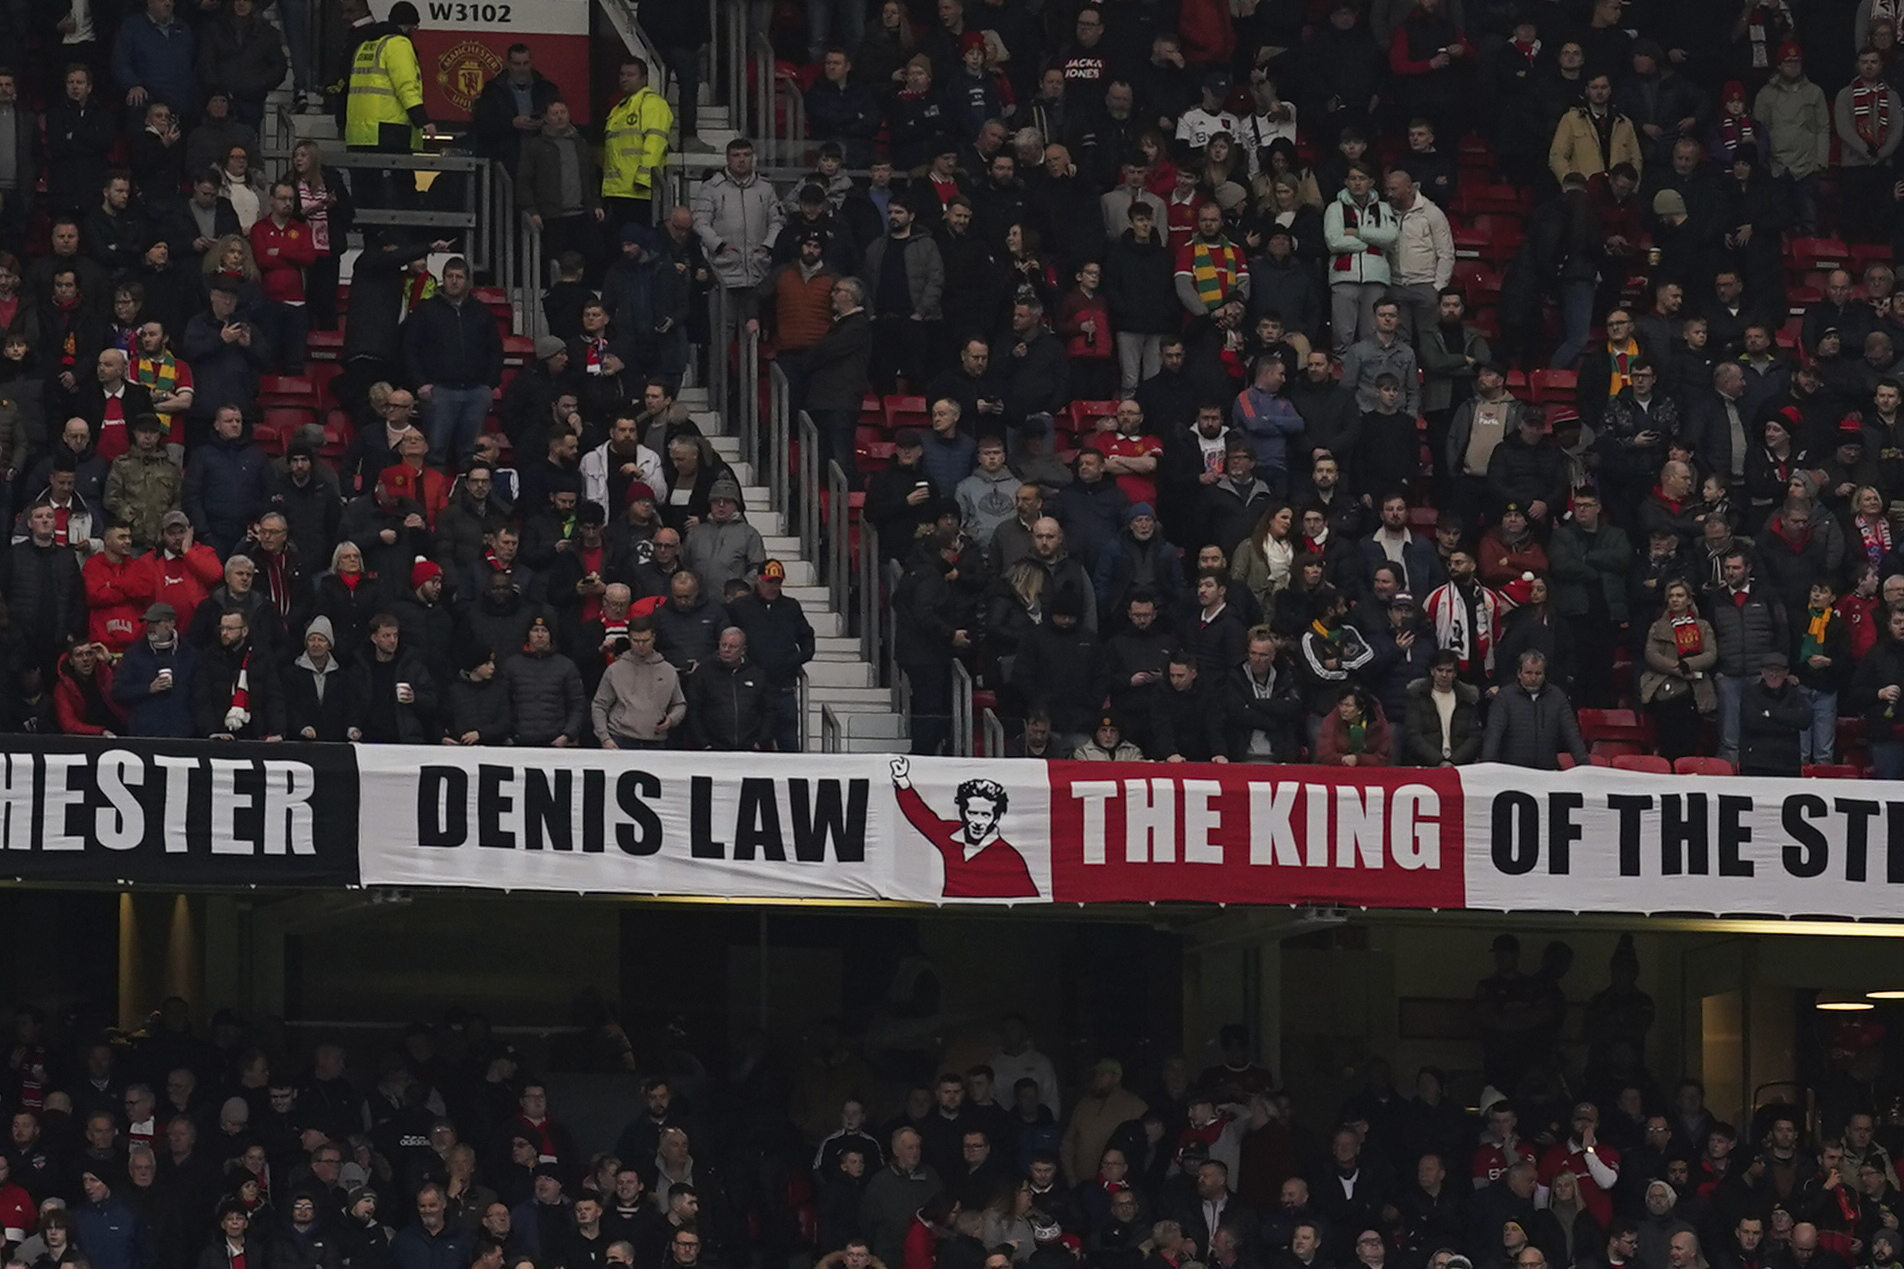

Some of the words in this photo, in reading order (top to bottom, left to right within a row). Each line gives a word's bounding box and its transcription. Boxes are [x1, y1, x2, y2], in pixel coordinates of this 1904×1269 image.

[428, 2, 511, 23] W3102
[444, 45, 498, 69] MANCHESTER
[1064, 68, 1101, 80] JONES
[418, 764, 662, 856] DENIS
[691, 776, 869, 862] LAW
[1071, 778, 1223, 864] THE
[1248, 782, 1440, 869] KING
[1491, 791, 1583, 875] OF
[1608, 793, 1754, 877] THE
